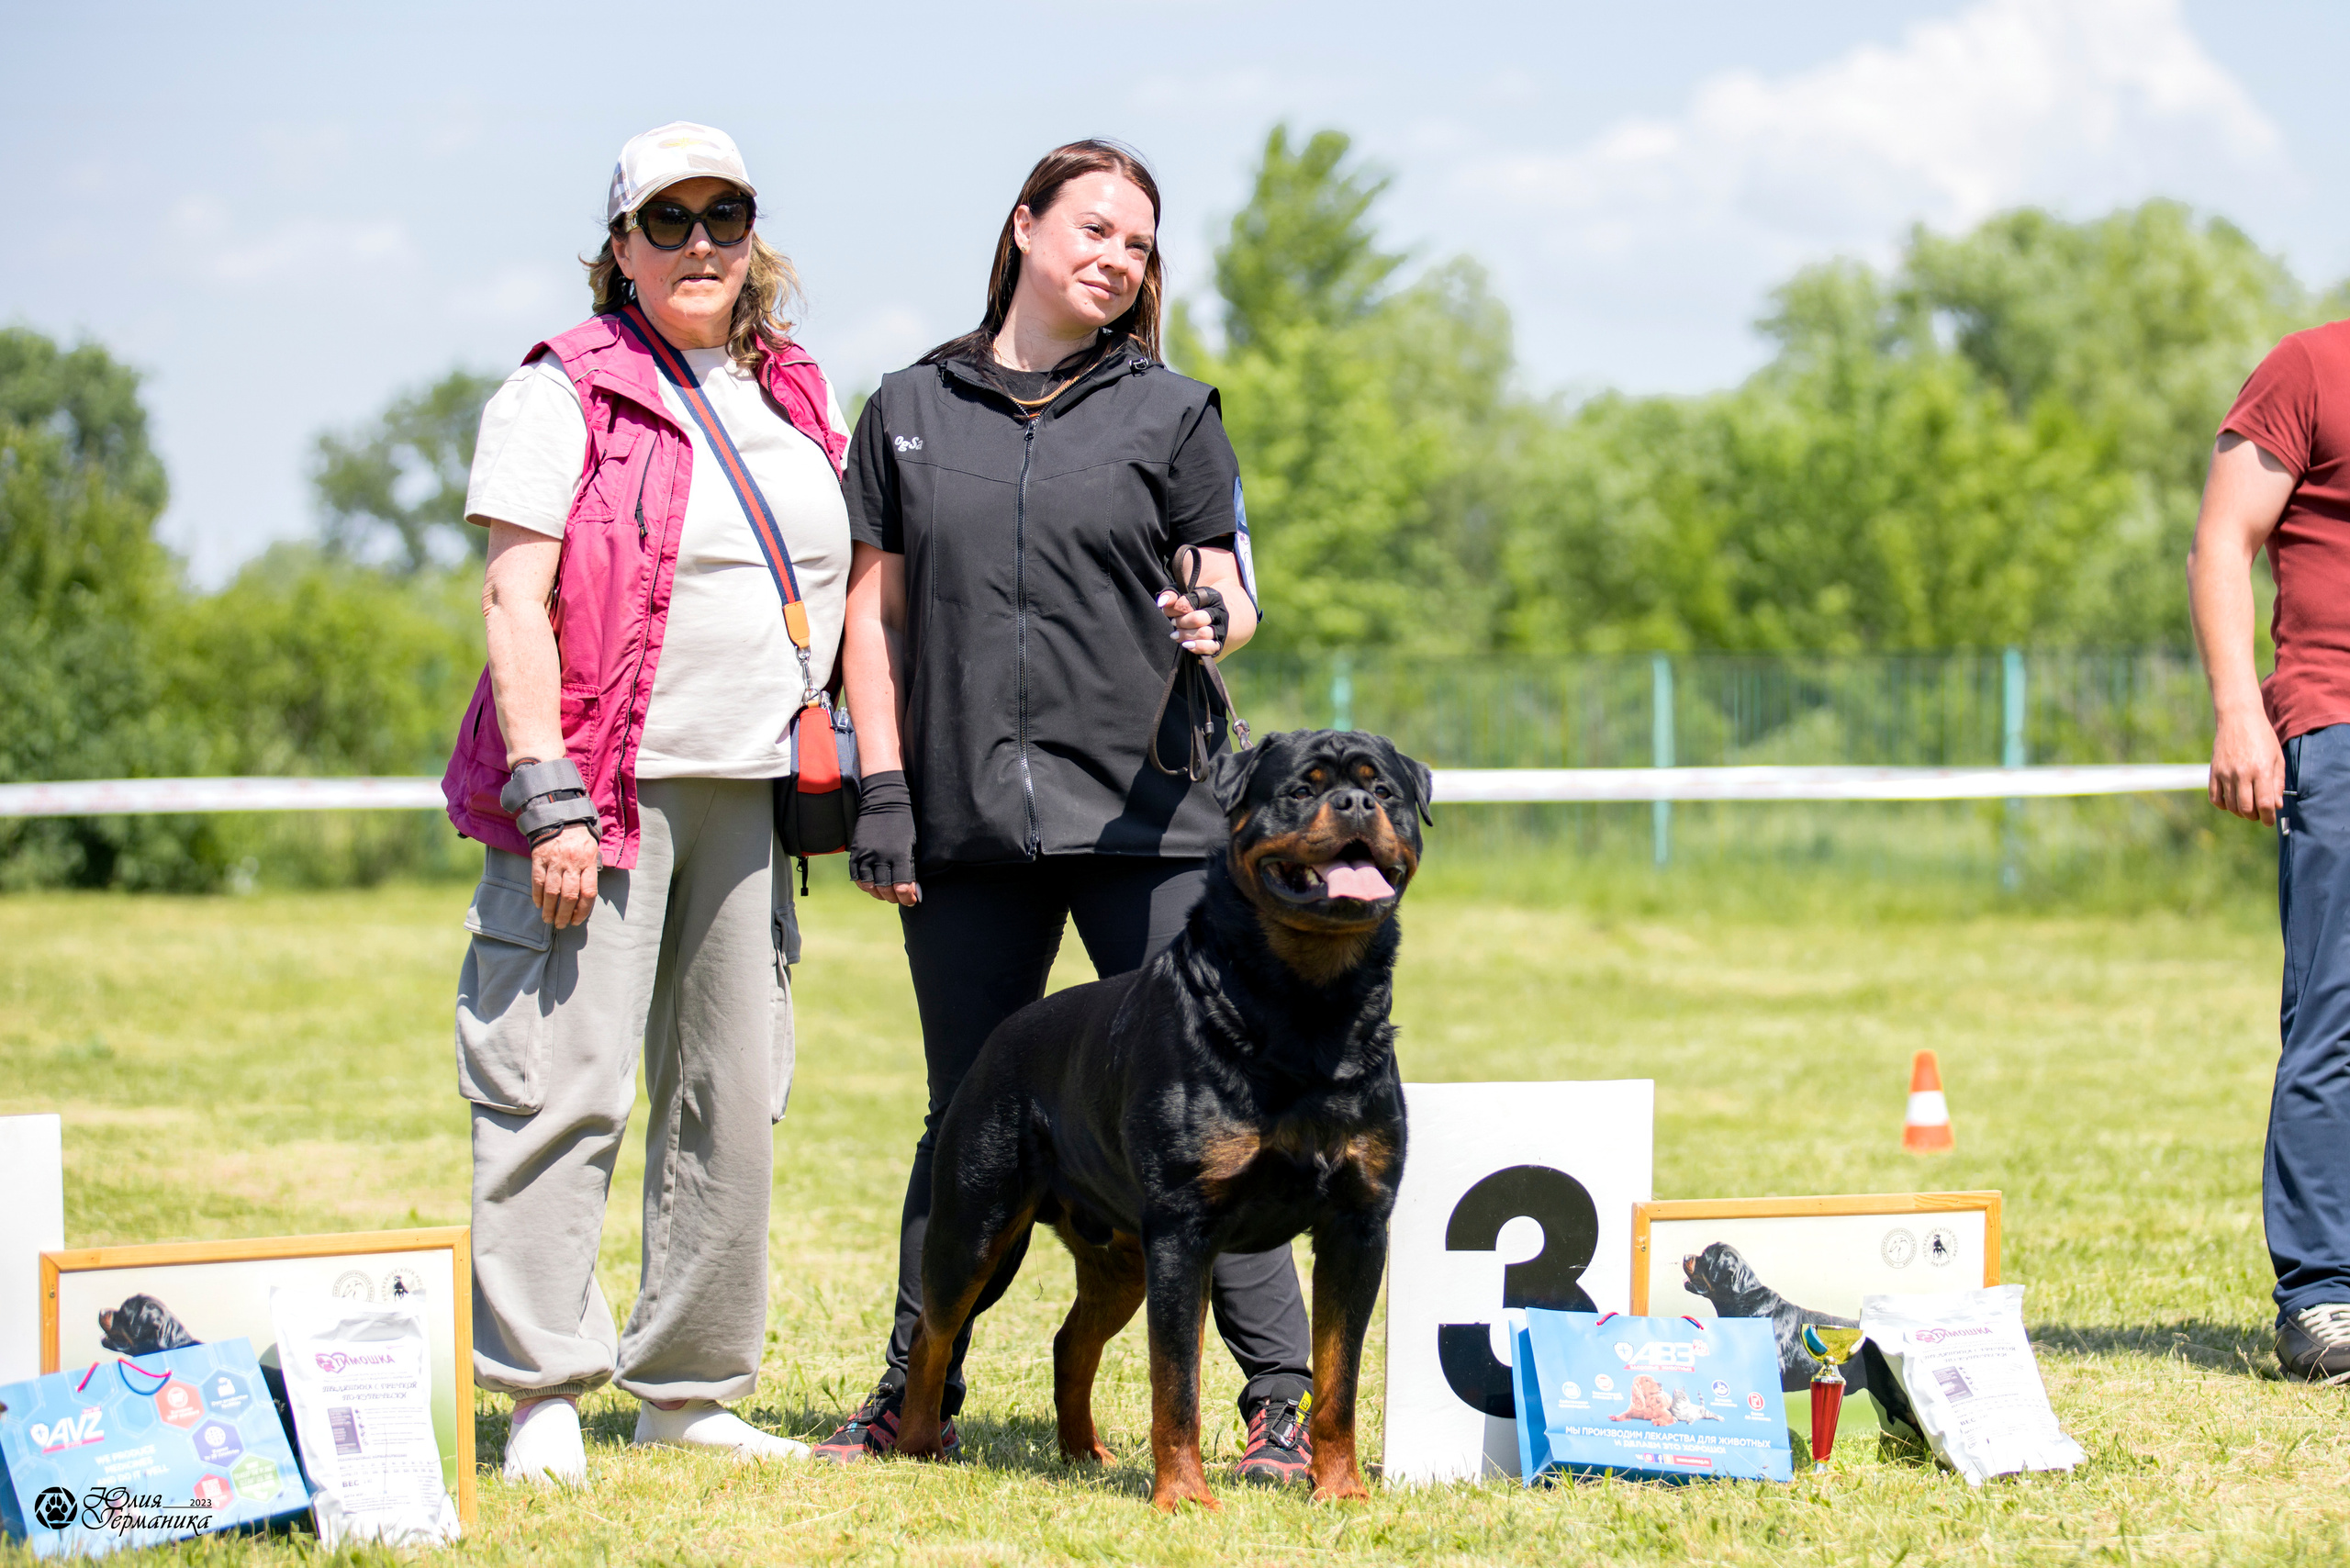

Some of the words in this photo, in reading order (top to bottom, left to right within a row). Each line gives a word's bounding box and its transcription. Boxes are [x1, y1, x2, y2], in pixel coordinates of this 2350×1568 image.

[1438, 1164, 1599, 1419] 3
[1628, 1341, 1695, 1368] АВЗ
[46, 1410, 105, 1447] AVZ
[1565, 1426, 1580, 1434] МЫ
[1582, 1427, 1642, 1439] ПРОИЗВОДИМ
[1644, 1431, 1695, 1443] ЛЕКАРСТВА
[1697, 1435, 1717, 1444] ДЛЯ
[1718, 1437, 1771, 1448] ЖИВОТНЫХ
[95, 1454, 112, 1466] WE
[112, 1444, 156, 1462] PRODUCE
[1623, 1439, 1662, 1450] ДЕЛАЕМ
[1662, 1442, 1681, 1450] ЭТО
[105, 1457, 154, 1474] MEDICINES
[96, 1475, 117, 1486] AND
[118, 1473, 132, 1483] DO
